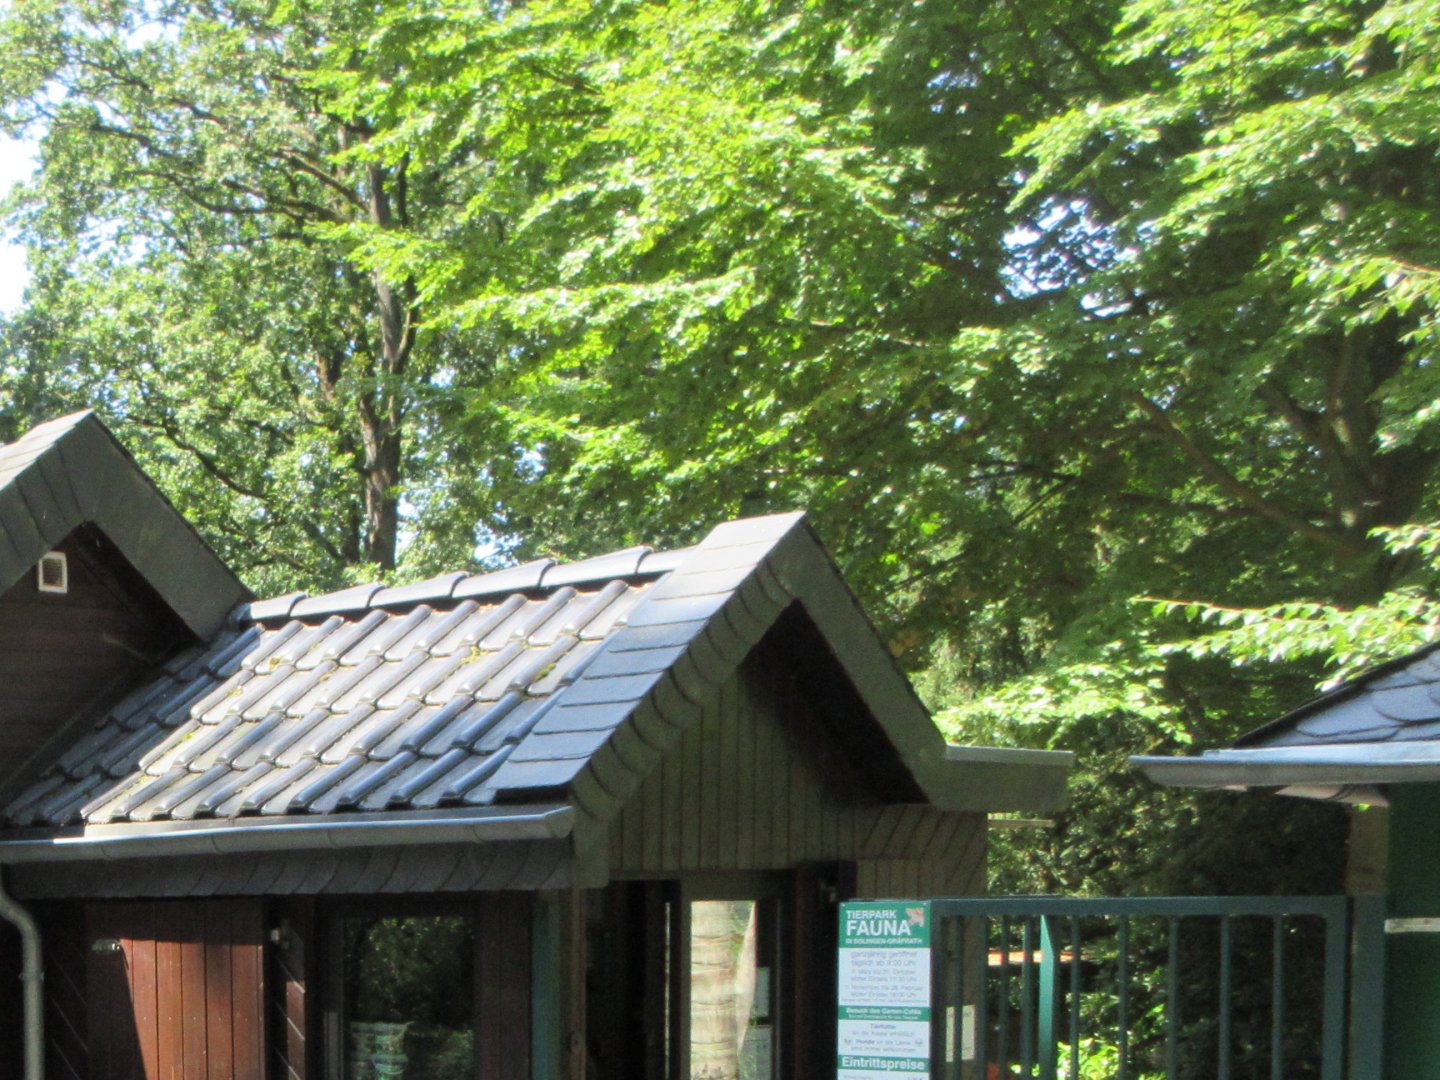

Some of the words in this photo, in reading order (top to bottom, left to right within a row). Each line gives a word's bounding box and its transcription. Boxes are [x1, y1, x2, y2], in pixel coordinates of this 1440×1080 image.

[846, 910, 897, 919] TIERPARK
[846, 920, 911, 936] FAUNA
[842, 1057, 925, 1071] Eintrittspreise
